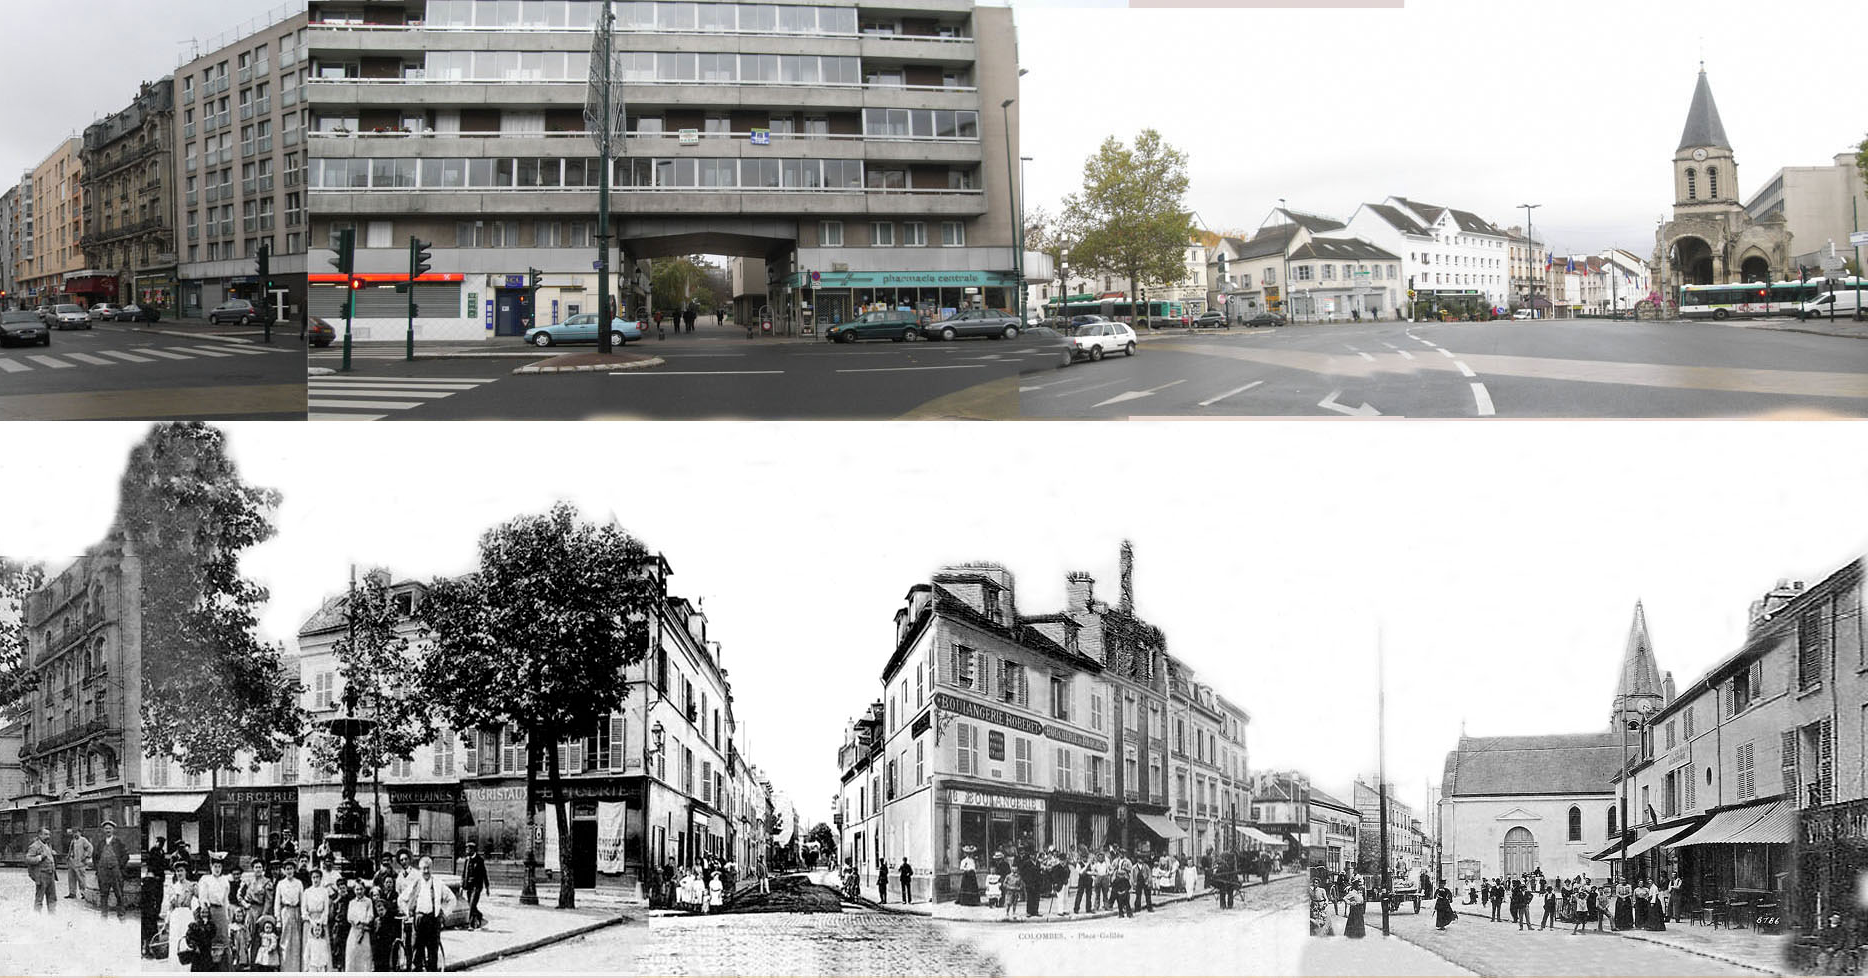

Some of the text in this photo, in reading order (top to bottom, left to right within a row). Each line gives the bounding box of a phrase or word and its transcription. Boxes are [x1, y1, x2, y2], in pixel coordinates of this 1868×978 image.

[883, 274, 979, 284] pharmacie centrale
[941, 695, 1004, 725] BOULANGERIE
[226, 791, 297, 801] MERCERIE
[390, 790, 453, 803] PORCELAINES
[460, 789, 471, 802] ET
